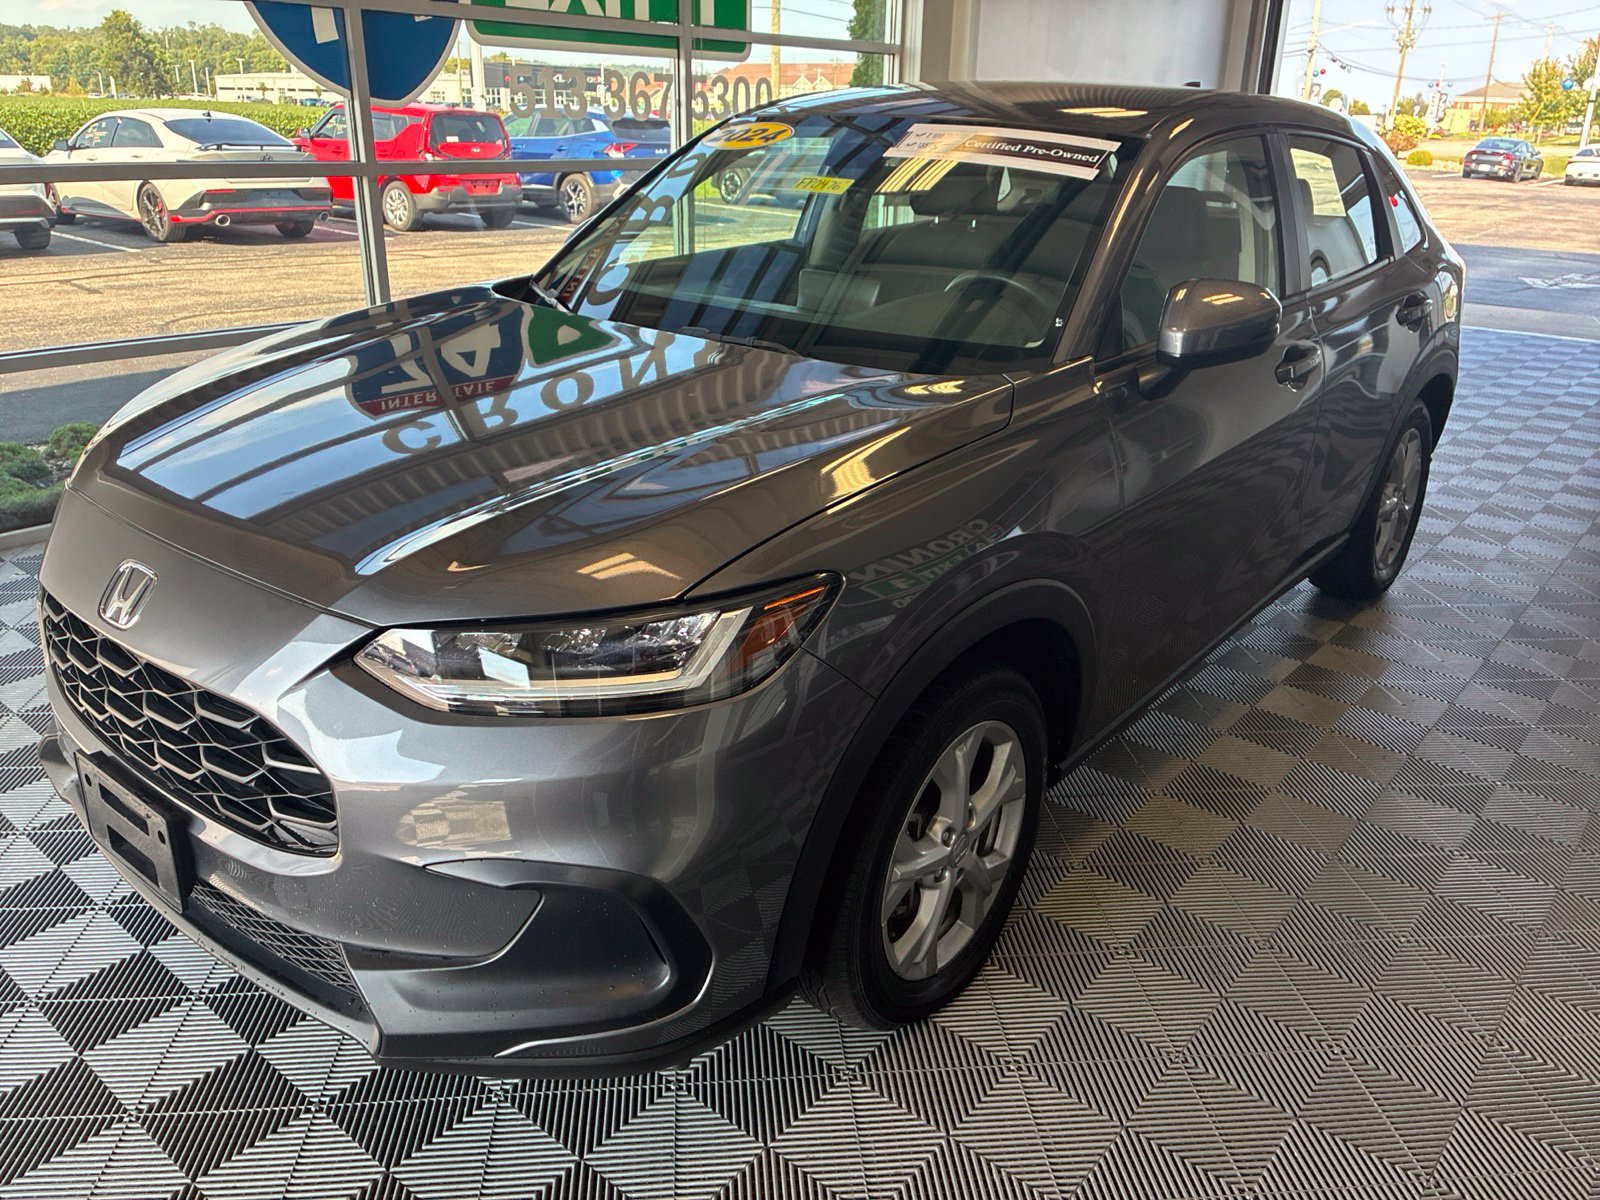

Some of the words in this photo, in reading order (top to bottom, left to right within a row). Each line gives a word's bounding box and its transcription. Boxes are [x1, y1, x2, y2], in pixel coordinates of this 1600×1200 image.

[708, 128, 787, 143] 2024
[964, 139, 1023, 152] Certified
[1022, 145, 1100, 163] Pre-Owned
